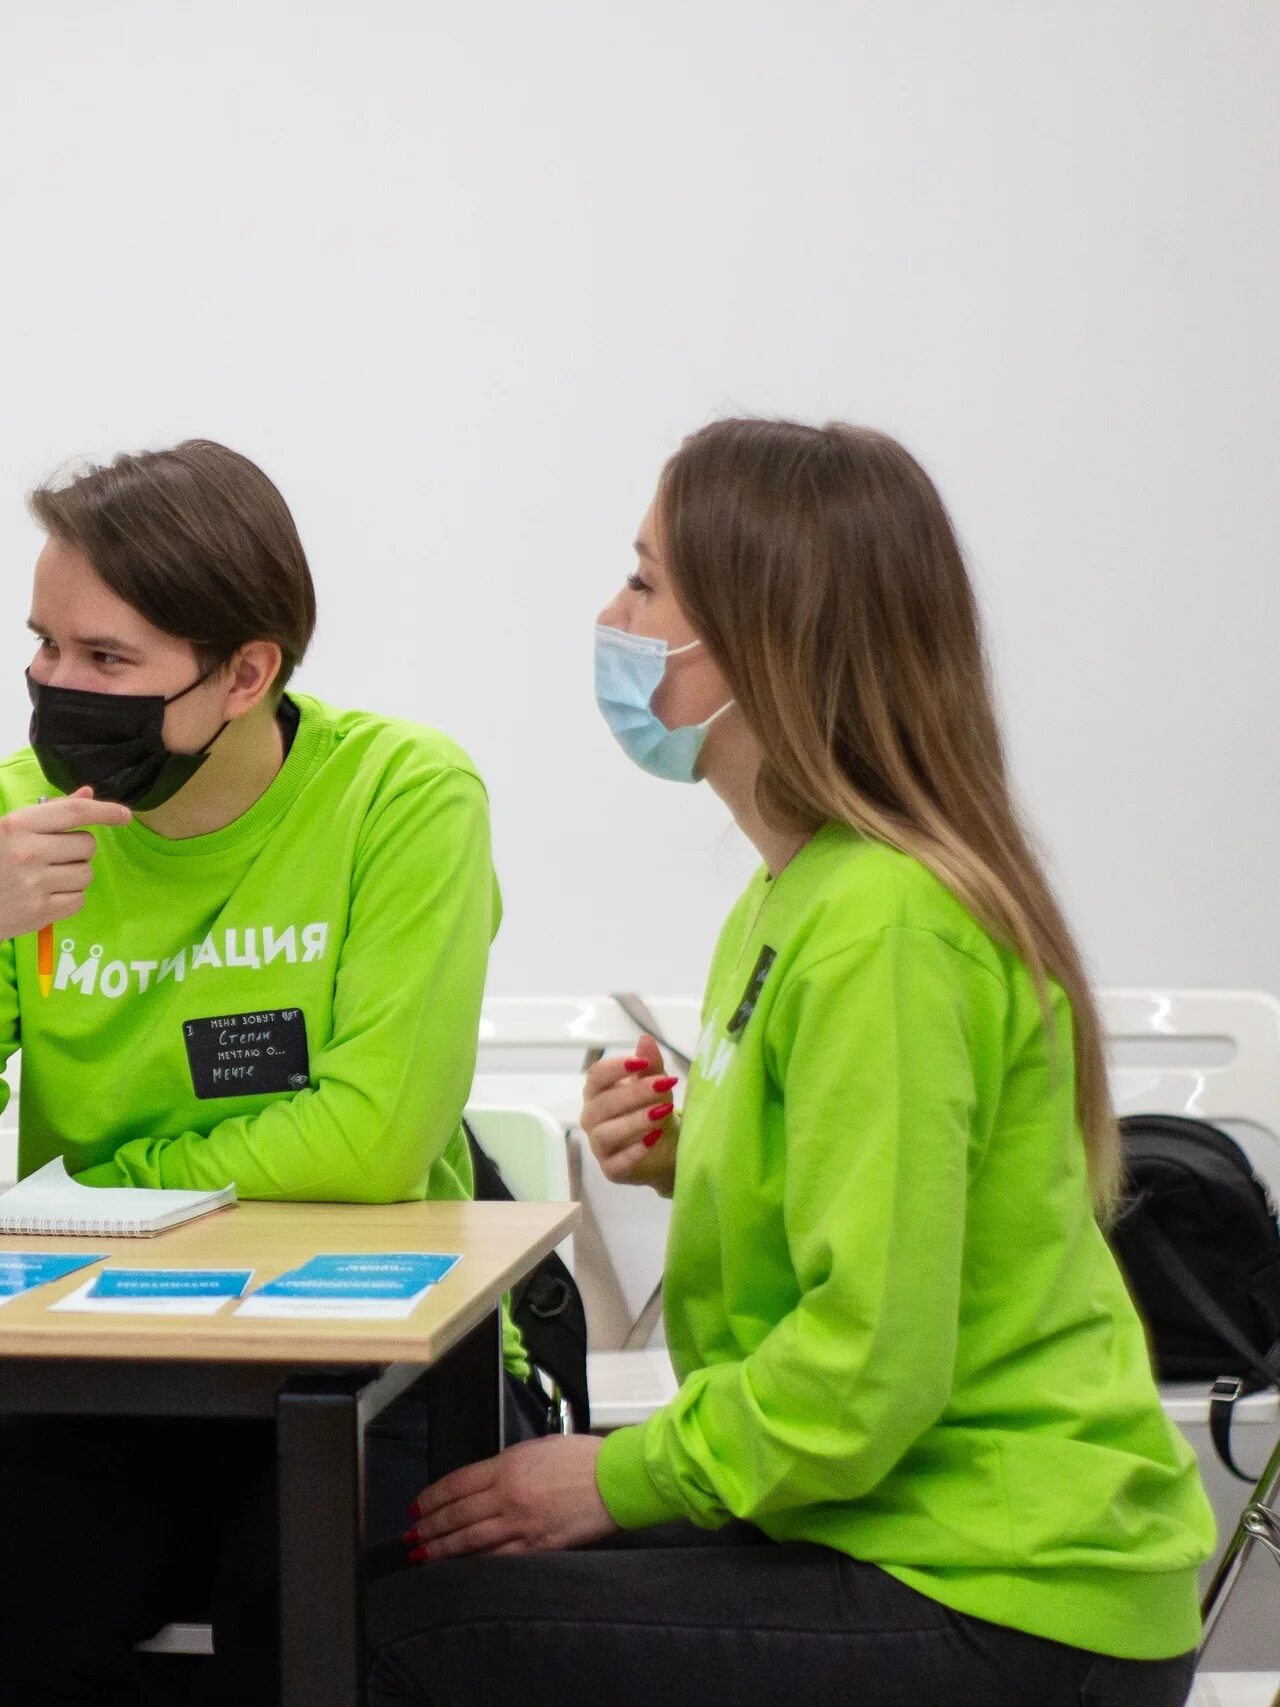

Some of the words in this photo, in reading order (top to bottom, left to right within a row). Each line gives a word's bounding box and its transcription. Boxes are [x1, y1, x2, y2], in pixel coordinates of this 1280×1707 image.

[54, 922, 328, 999] МОТИАЦИЯ
[211, 1019, 236, 1029] МЕНЯ
[242, 1013, 275, 1025] ЗОВУТ
[217, 1049, 260, 1061] МЕЧТАЮ
